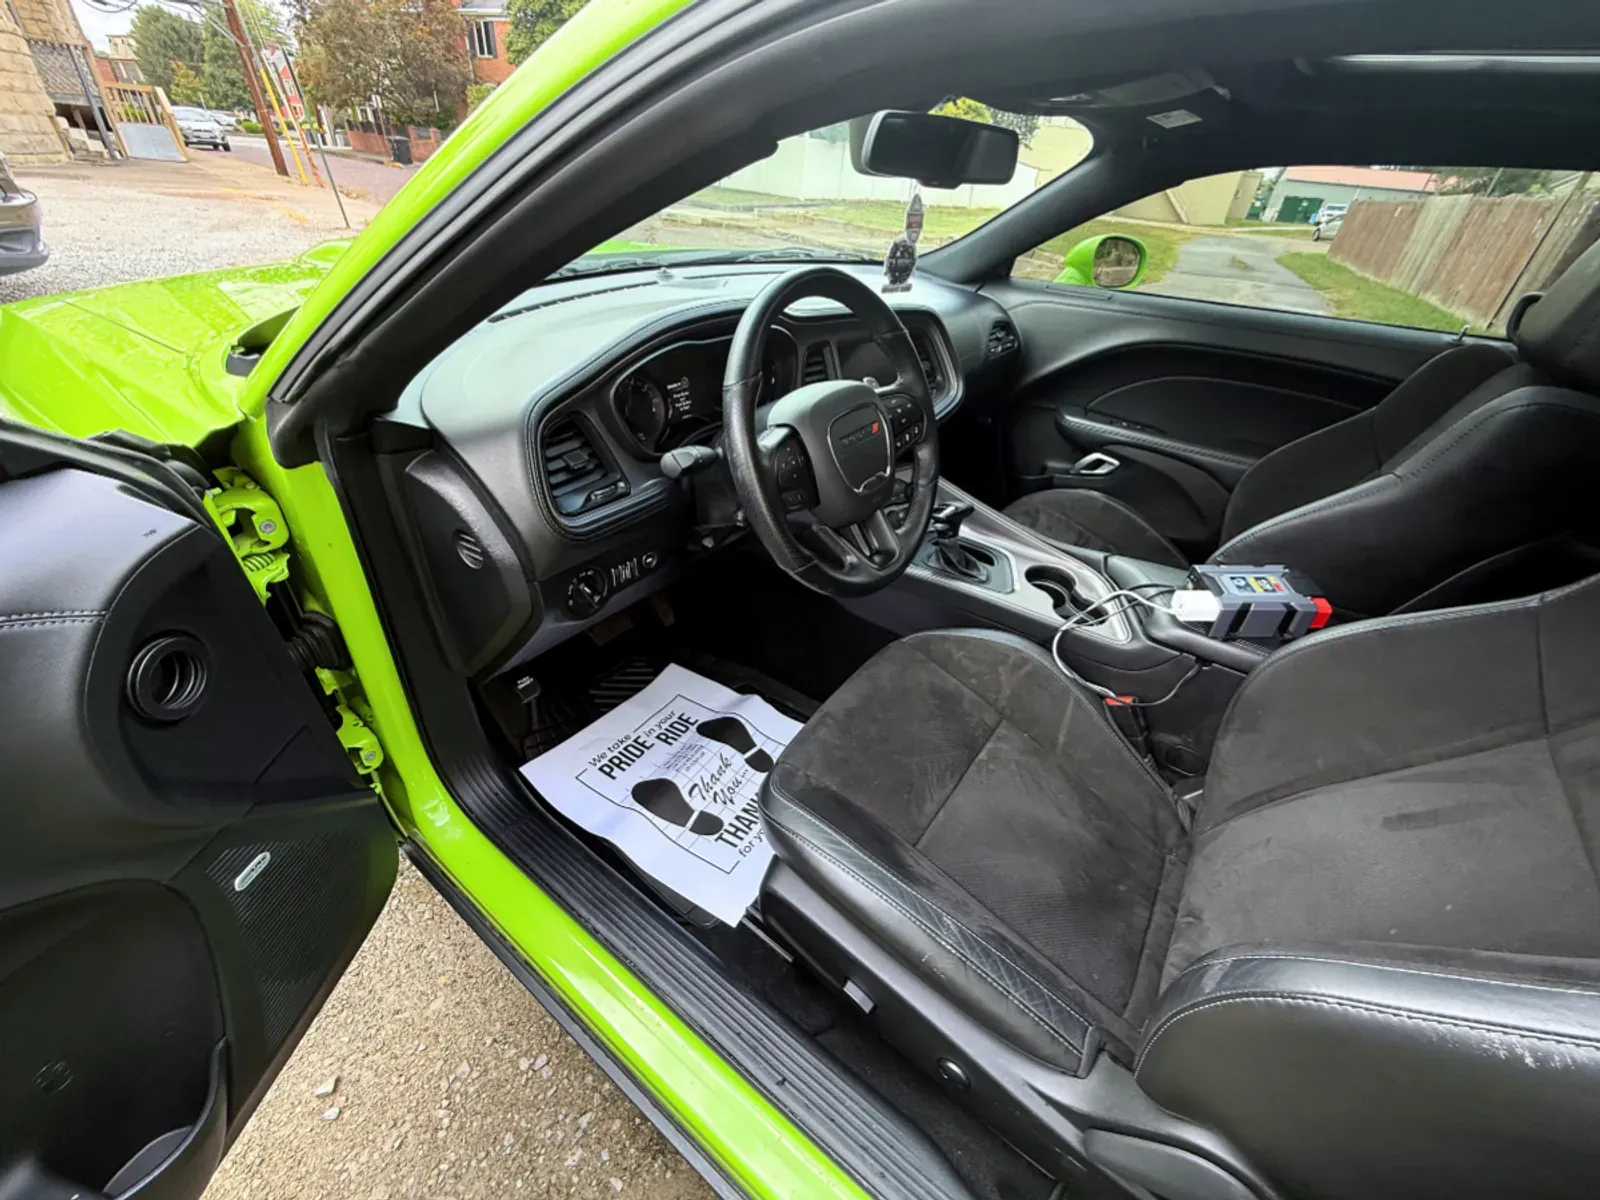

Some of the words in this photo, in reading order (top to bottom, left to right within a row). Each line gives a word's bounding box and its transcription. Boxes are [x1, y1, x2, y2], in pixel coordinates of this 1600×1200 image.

[643, 727, 656, 738] in
[654, 710, 676, 730] your
[588, 751, 608, 767] We
[606, 733, 632, 754] take
[598, 735, 656, 780] PRIDE
[655, 712, 700, 746] RIDE
[688, 752, 732, 801] Thank
[738, 840, 756, 857] for
[754, 827, 765, 843] yo
